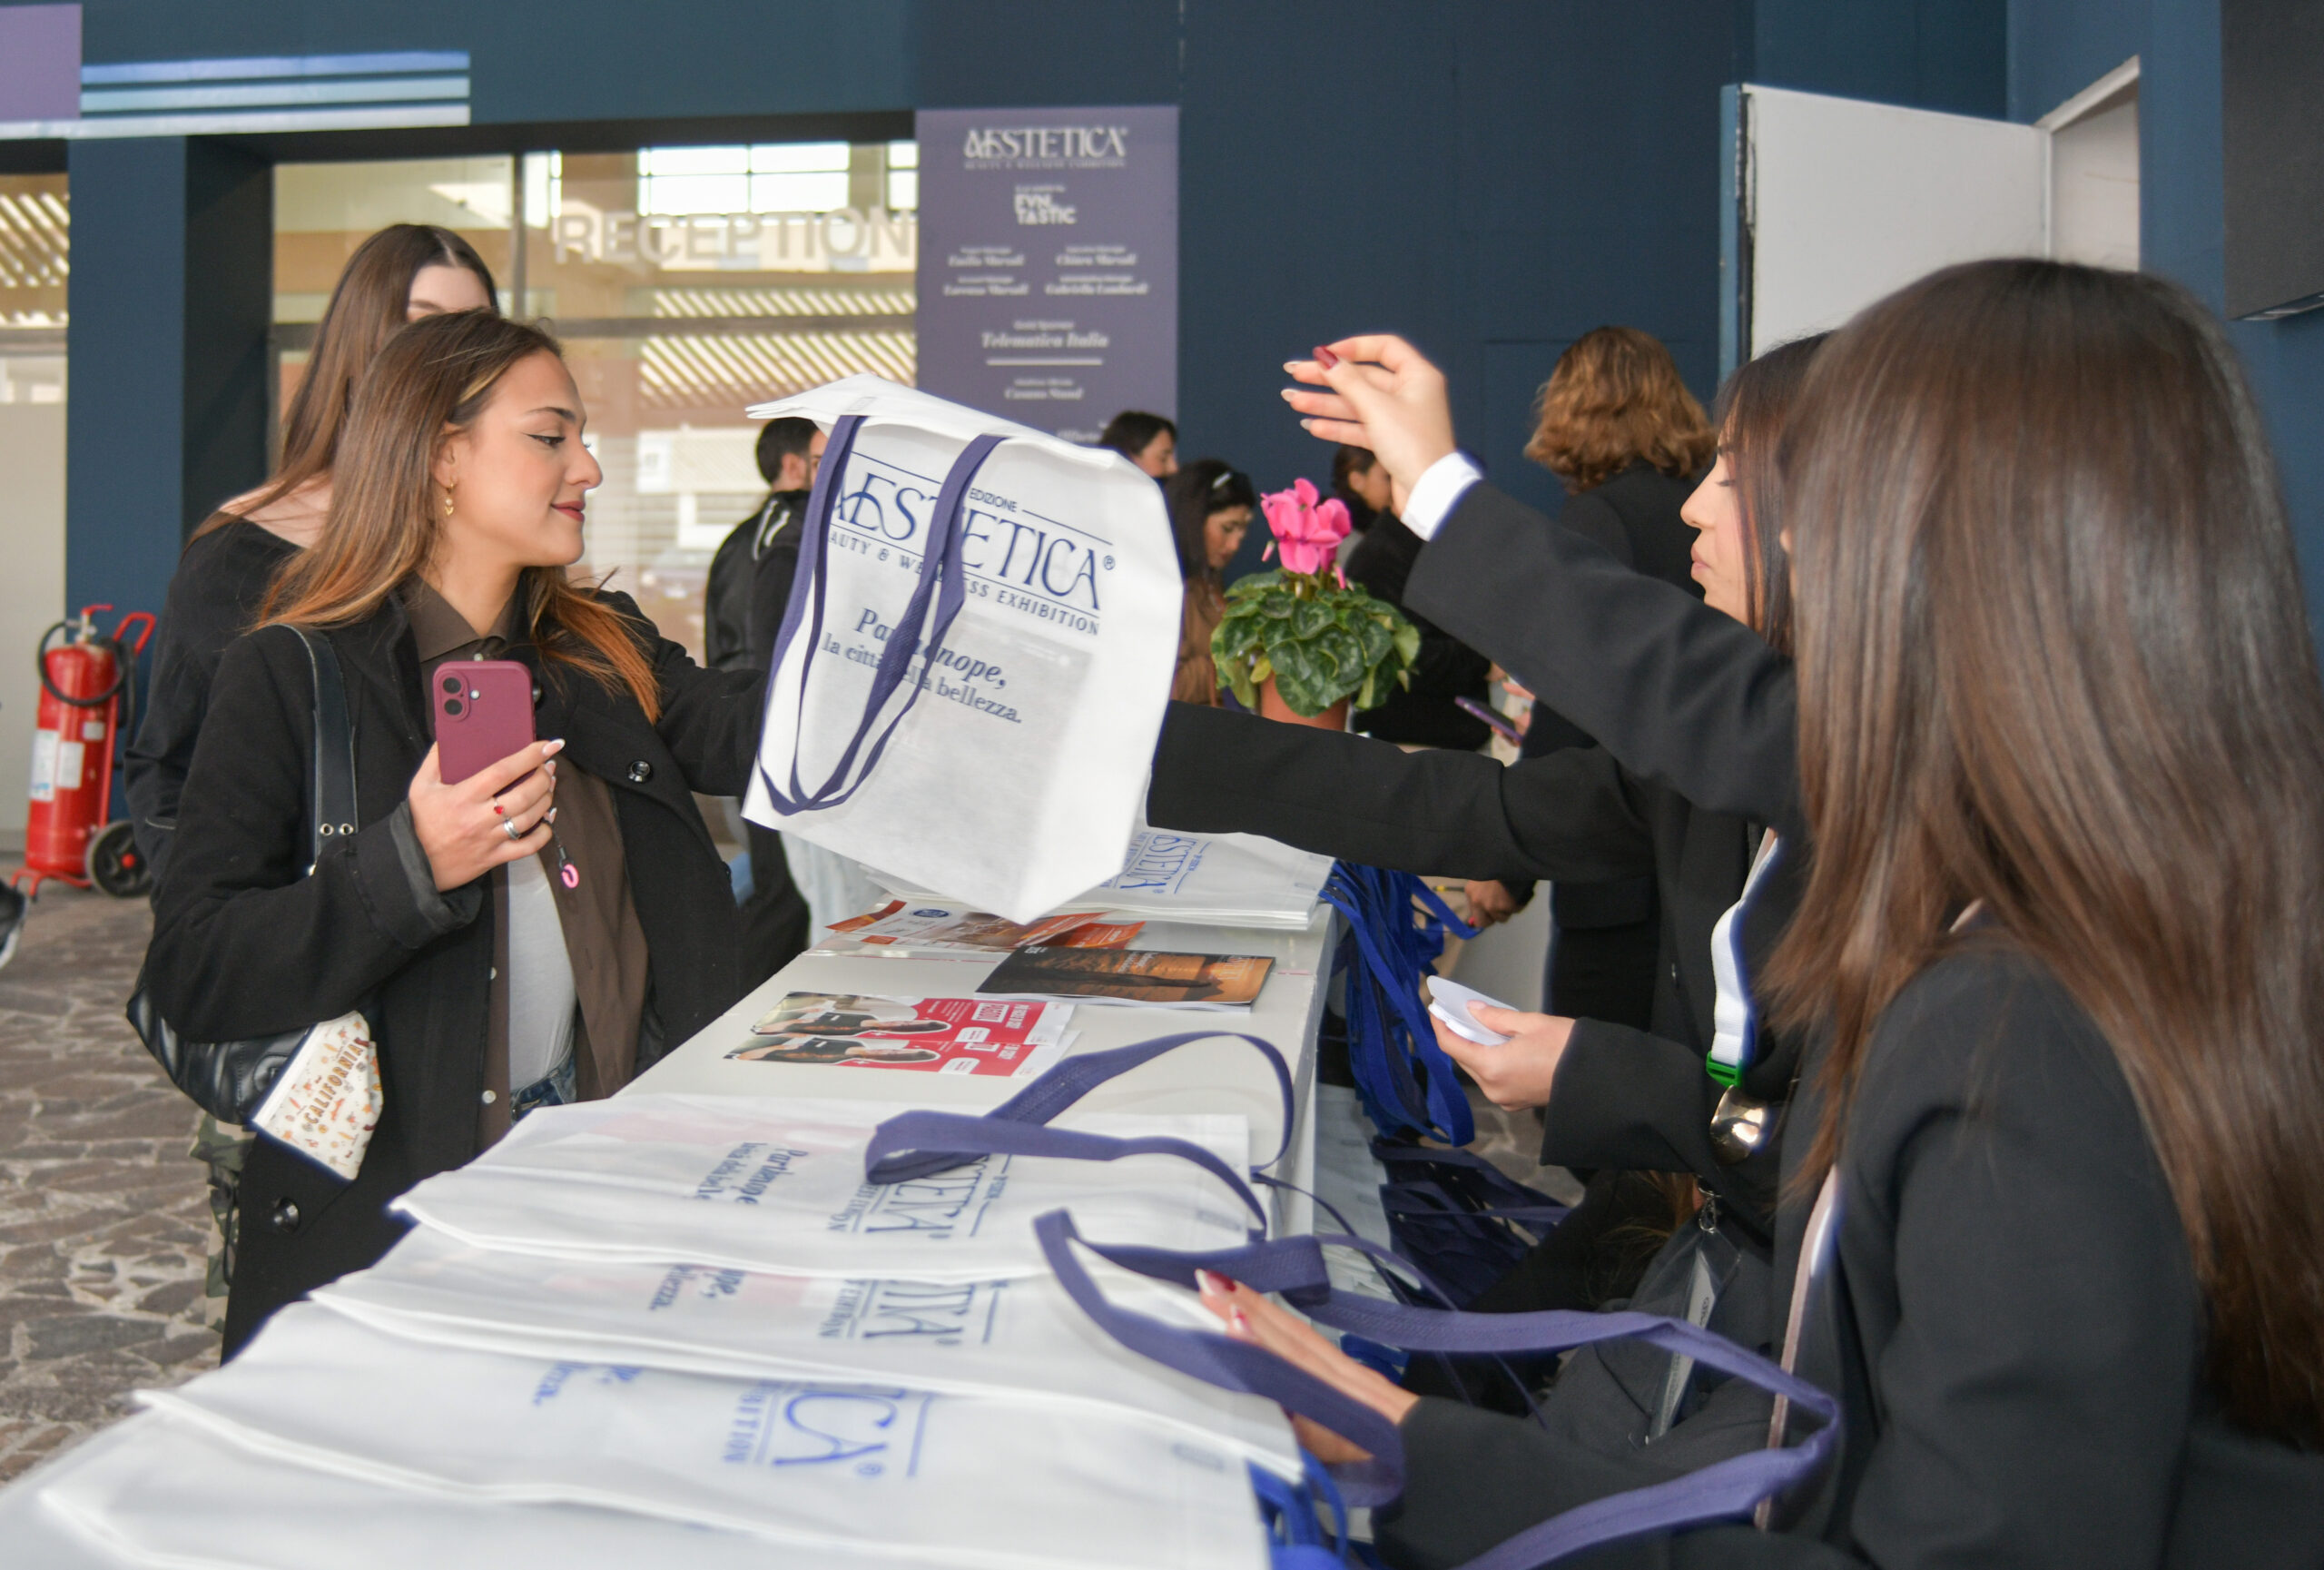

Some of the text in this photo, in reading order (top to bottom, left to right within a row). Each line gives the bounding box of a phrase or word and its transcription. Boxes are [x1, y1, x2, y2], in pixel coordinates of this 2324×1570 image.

[555, 207, 909, 264] RECEPTION
[968, 487, 1018, 513] EDIZIONE
[828, 531, 872, 556] AUTY
[877, 548, 890, 562] &
[996, 589, 1100, 637] EXHIBITION
[821, 632, 841, 655] la
[844, 644, 883, 669] citt
[936, 676, 1022, 724] bellezza.
[304, 1043, 364, 1124] CALIFORNIA
